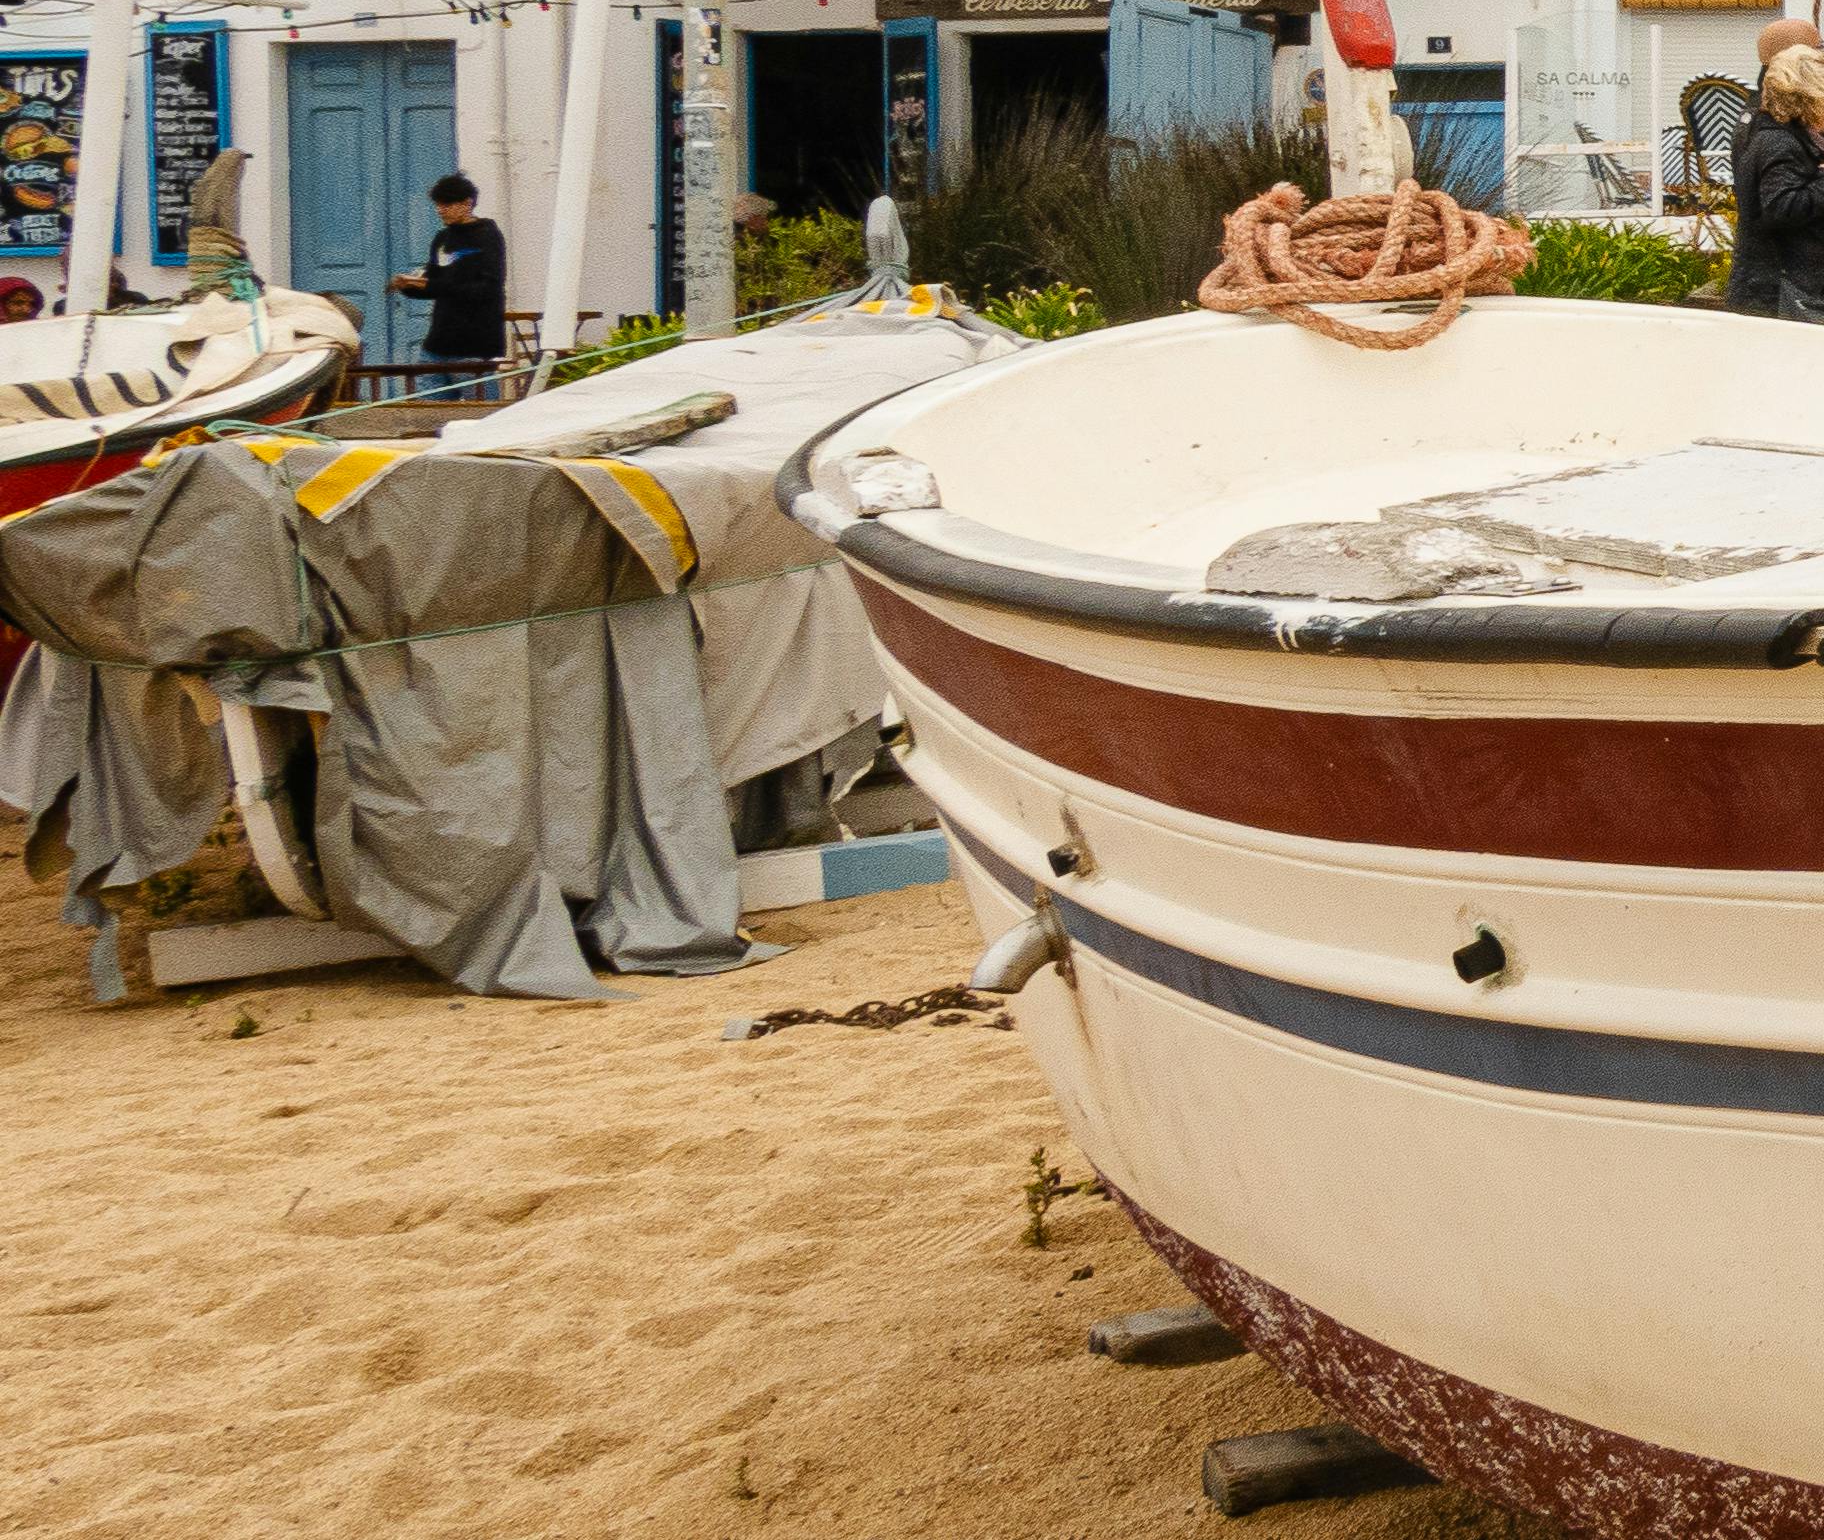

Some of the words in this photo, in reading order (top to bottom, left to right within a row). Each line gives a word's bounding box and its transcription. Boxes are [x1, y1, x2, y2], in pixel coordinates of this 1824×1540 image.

[1434, 38, 1445, 50] 9
[1536, 71, 1560, 86] SA
[1566, 70, 1631, 86] CALMA
